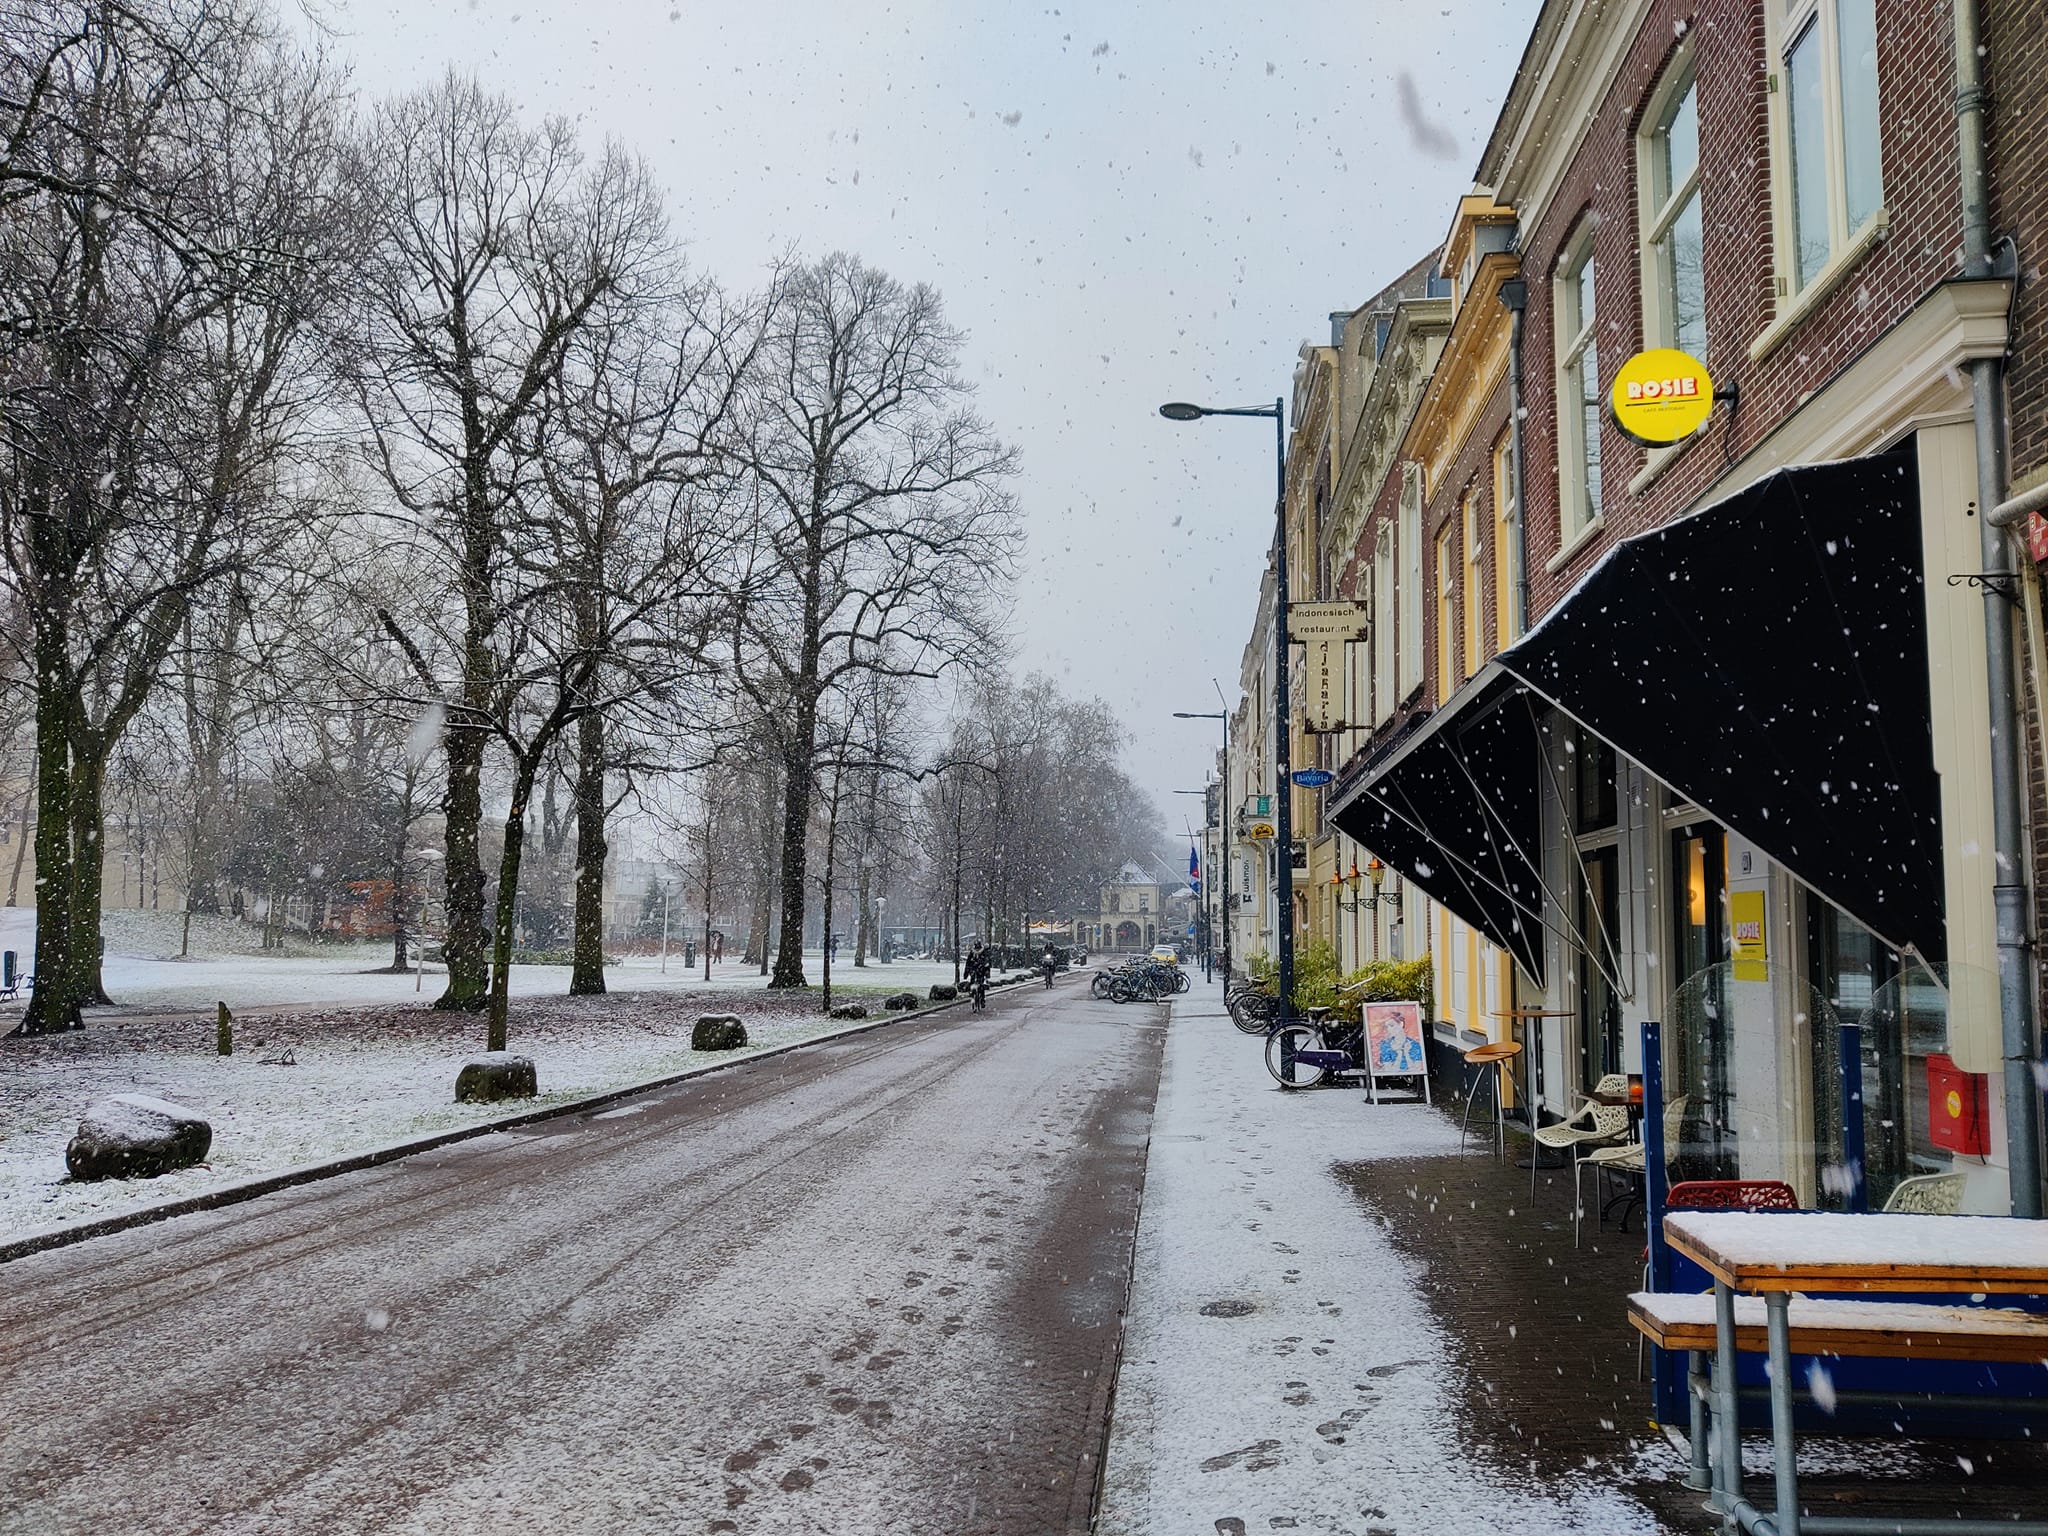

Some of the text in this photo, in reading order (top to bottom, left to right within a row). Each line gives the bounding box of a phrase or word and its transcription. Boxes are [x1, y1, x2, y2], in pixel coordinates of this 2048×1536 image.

[1627, 377, 1698, 400] ROSIE
[1297, 774, 1329, 782] Bavaria
[1736, 921, 1761, 940] ROSIE
